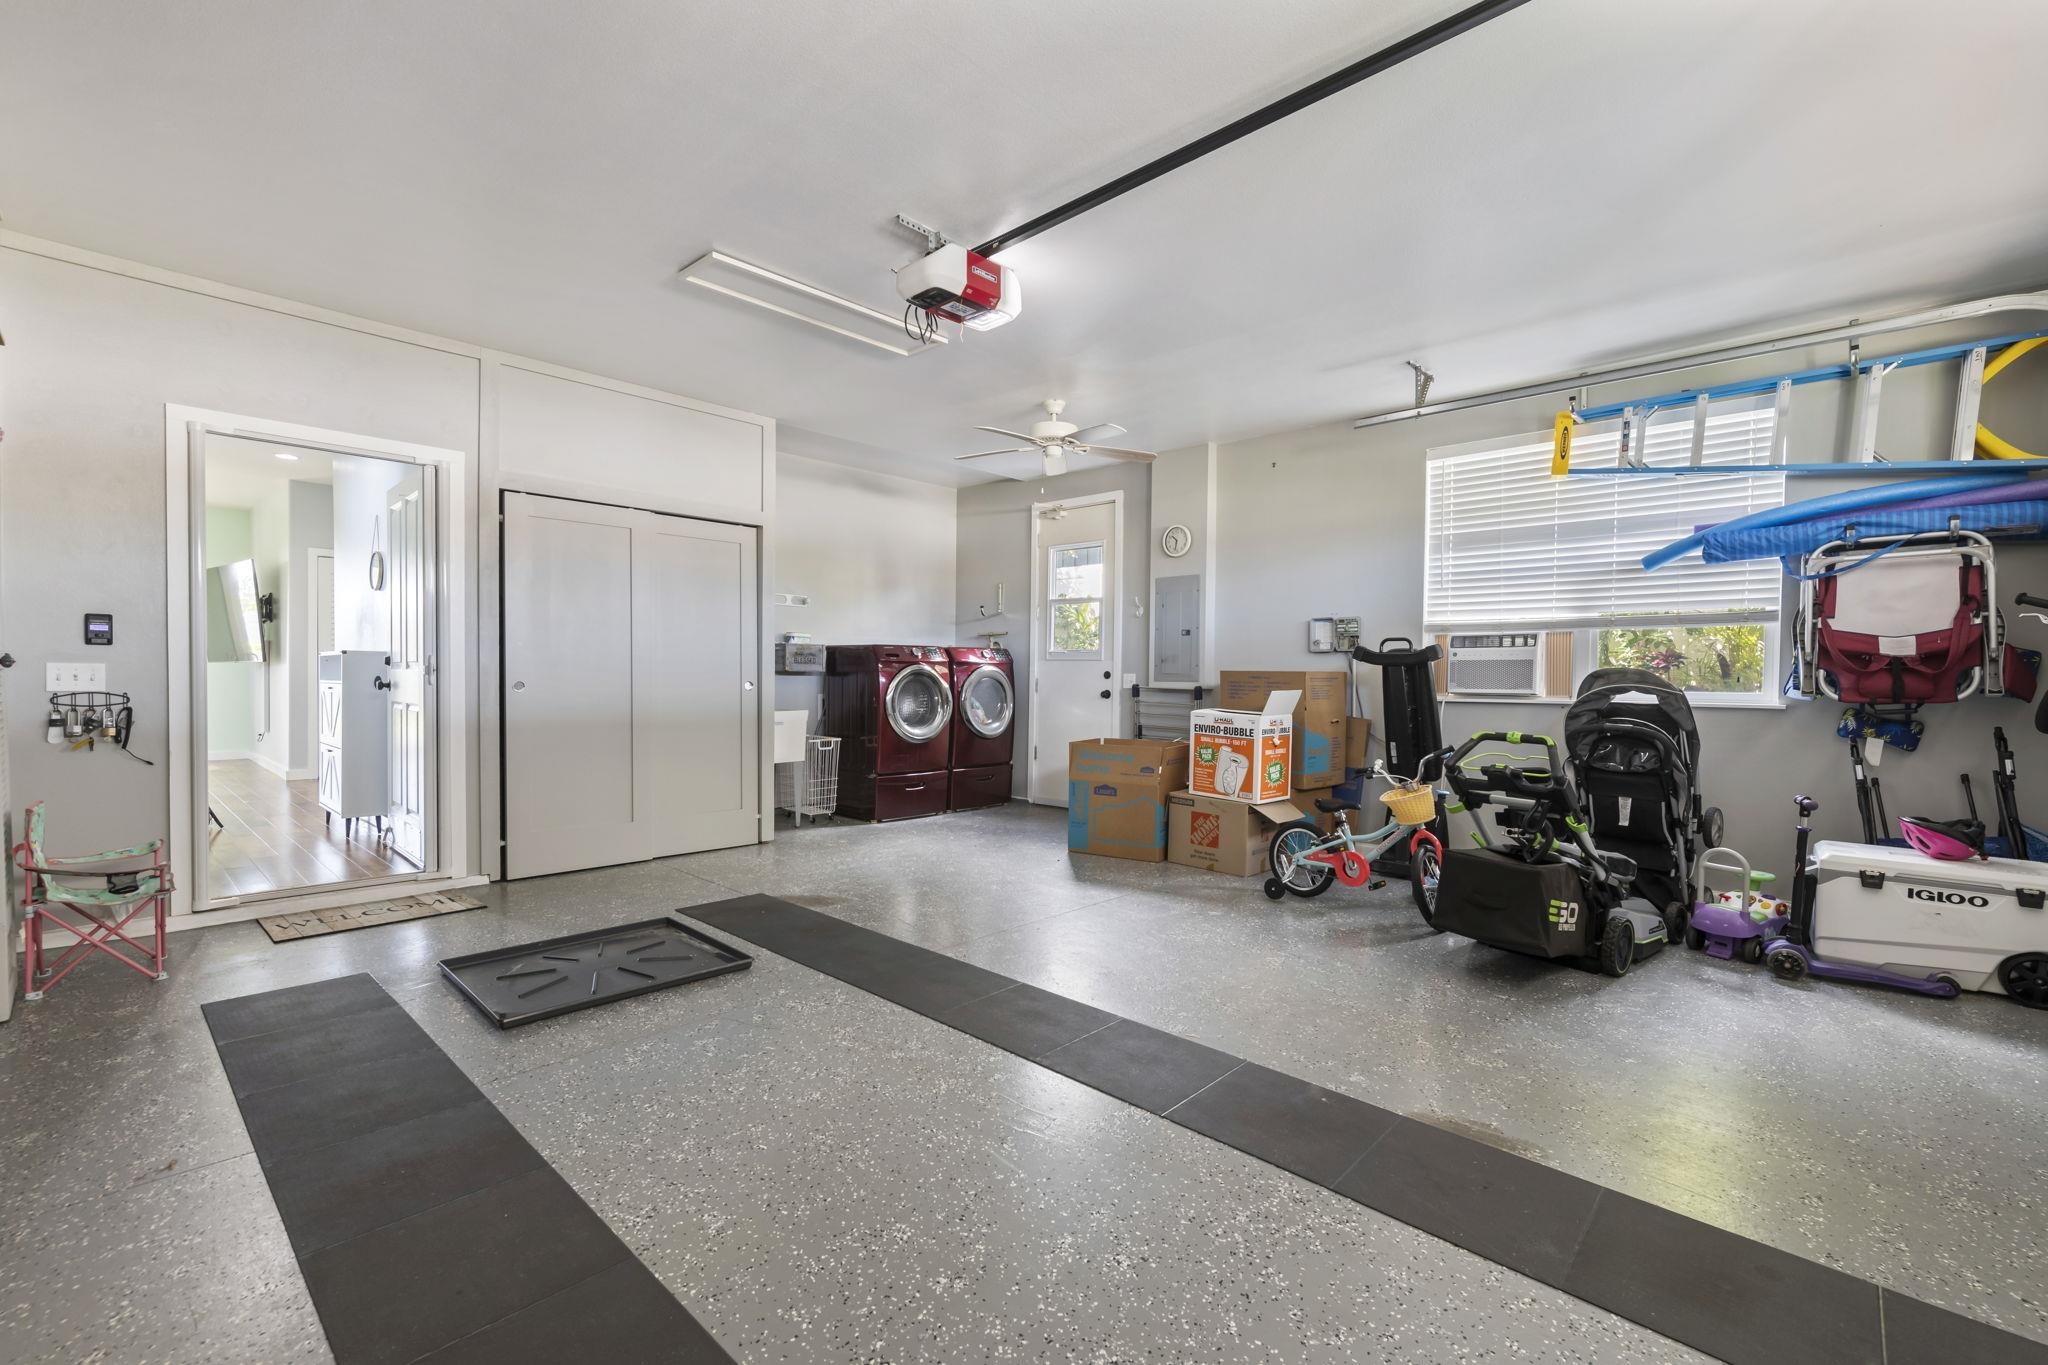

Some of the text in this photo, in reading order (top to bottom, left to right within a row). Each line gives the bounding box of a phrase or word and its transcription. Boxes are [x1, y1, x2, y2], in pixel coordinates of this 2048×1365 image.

[1194, 724, 1255, 737] ENVIRO-BUBBLE
[1191, 815, 1219, 844] HOME
[1907, 887, 1989, 908] IGLOO
[275, 894, 468, 930] WELCOME
[1549, 900, 1579, 923] EGO
